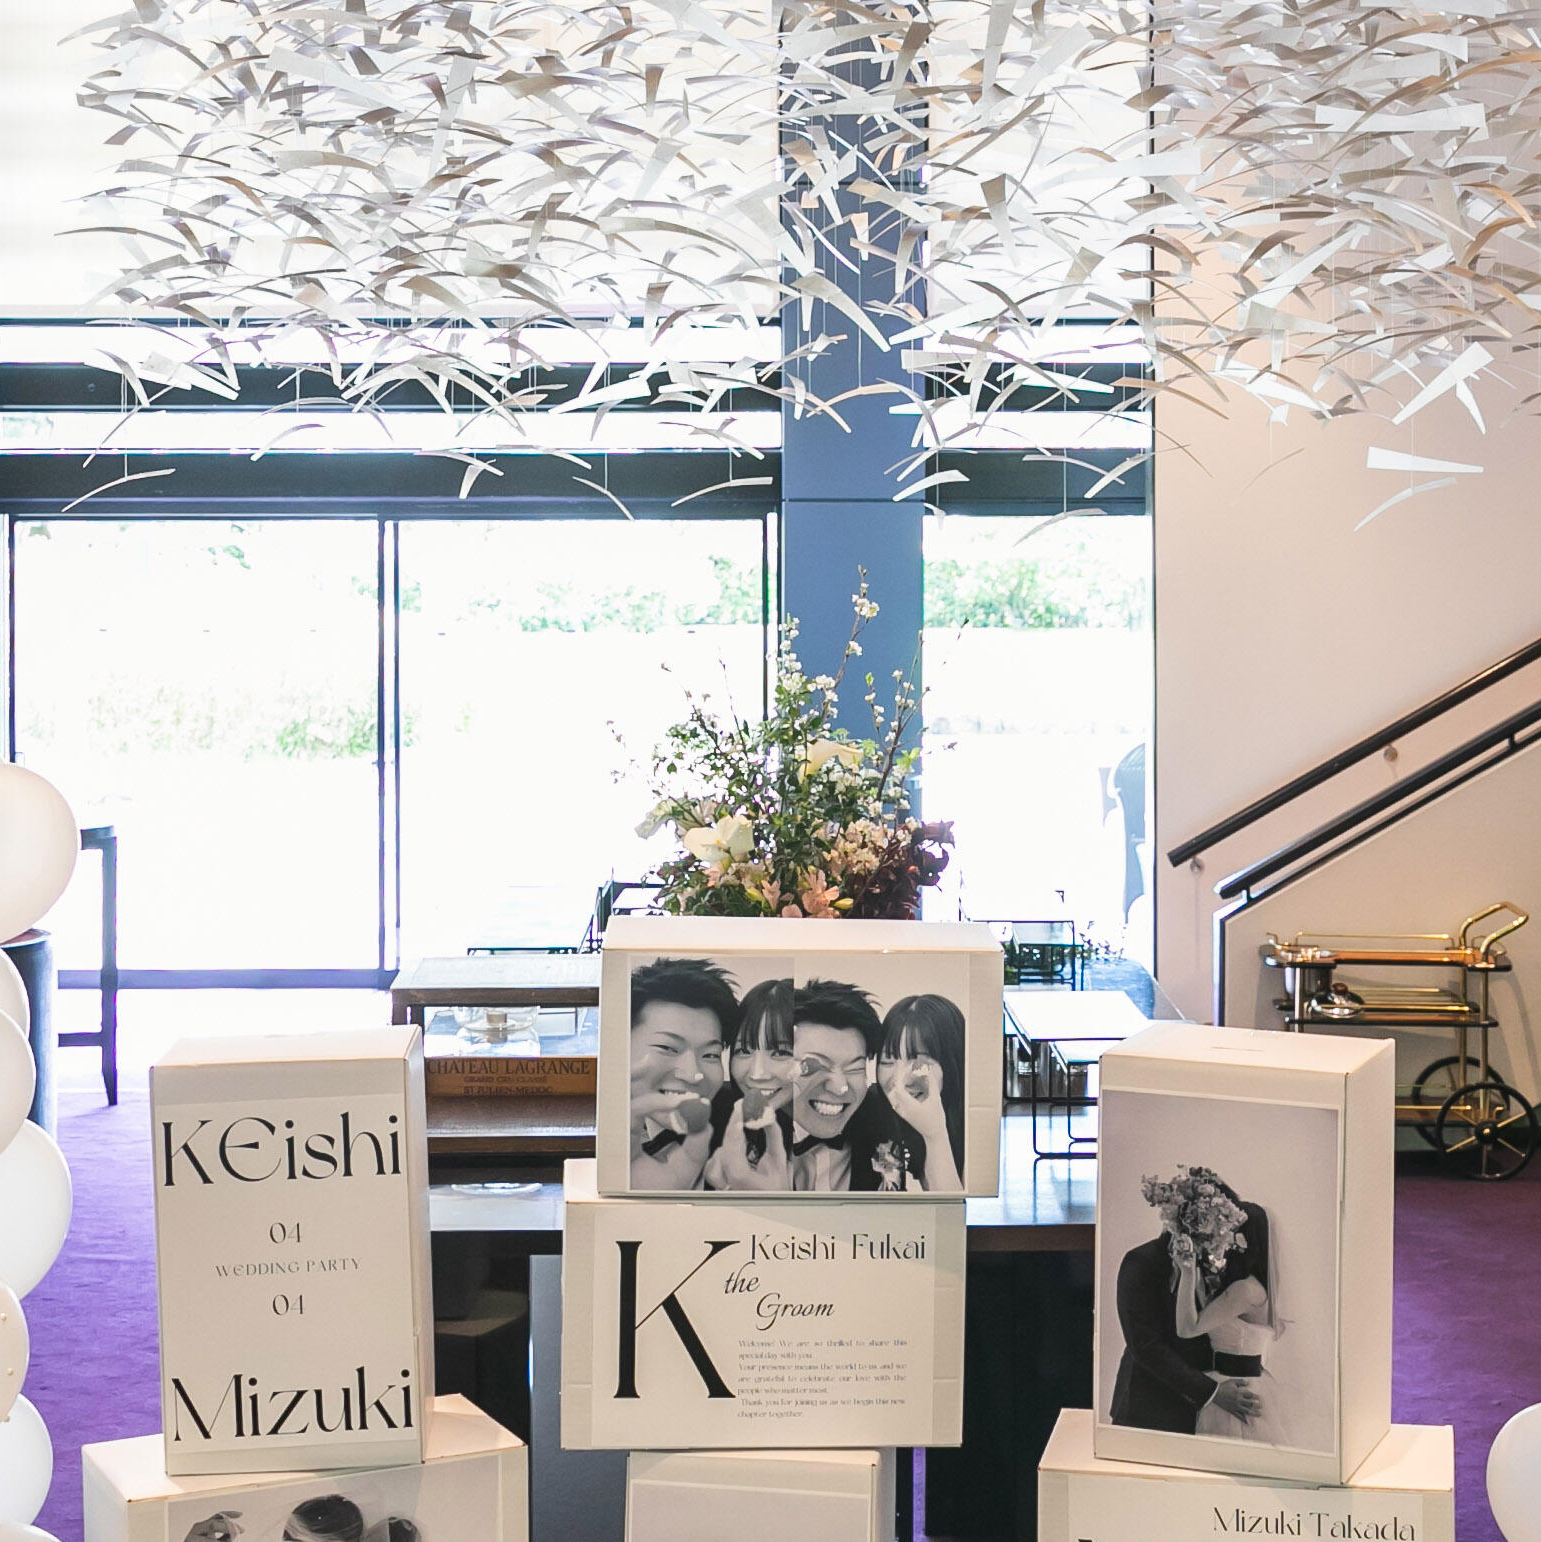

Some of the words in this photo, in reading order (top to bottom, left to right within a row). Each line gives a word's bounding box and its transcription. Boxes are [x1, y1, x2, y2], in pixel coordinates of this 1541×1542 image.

[506, 1060, 590, 1075] LAGRANGE
[269, 1222, 302, 1244] 04
[751, 1234, 836, 1261] Keishi
[851, 1233, 926, 1261] Fukai
[215, 1261, 300, 1278] WEDDING
[306, 1257, 362, 1273] PARTY
[724, 1261, 760, 1294] the
[272, 1294, 305, 1316] 04
[613, 1240, 741, 1399] K
[756, 1293, 835, 1331] Groom
[171, 1366, 414, 1442] Mizuki
[1213, 1507, 1301, 1537] Mizuki
[1309, 1512, 1416, 1541] Takada
